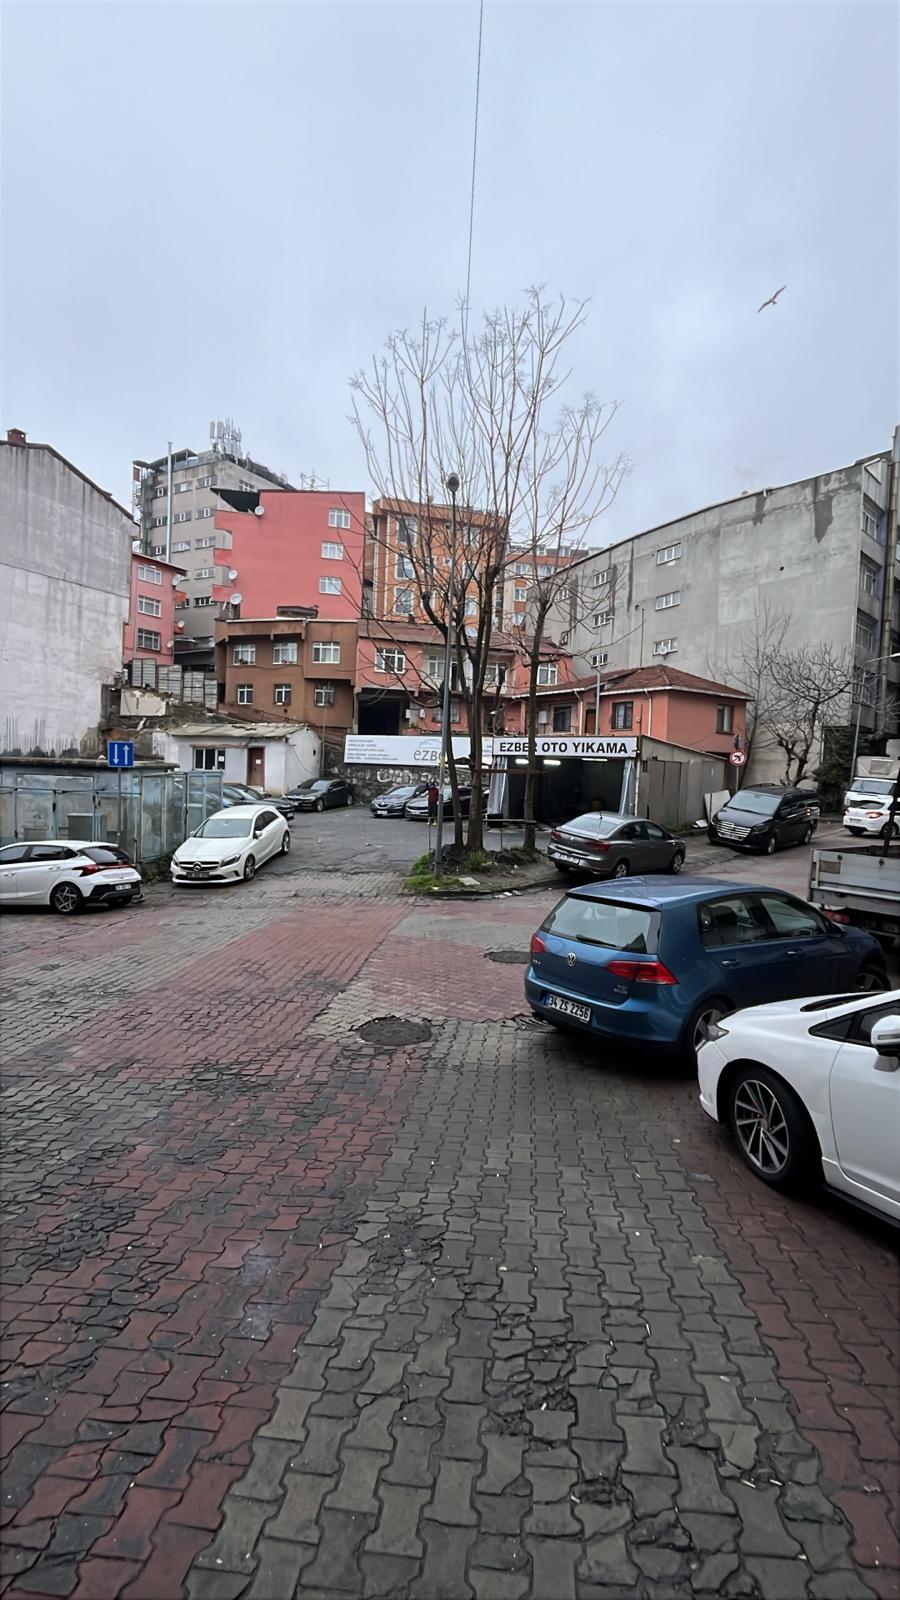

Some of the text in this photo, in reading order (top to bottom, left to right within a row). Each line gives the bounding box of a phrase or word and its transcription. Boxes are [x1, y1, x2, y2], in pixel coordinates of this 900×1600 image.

[541, 742, 568, 753] OTO
[572, 742, 628, 754] YIKAMA
[550, 995, 558, 1008] 34
[560, 999, 569, 1012] ZS
